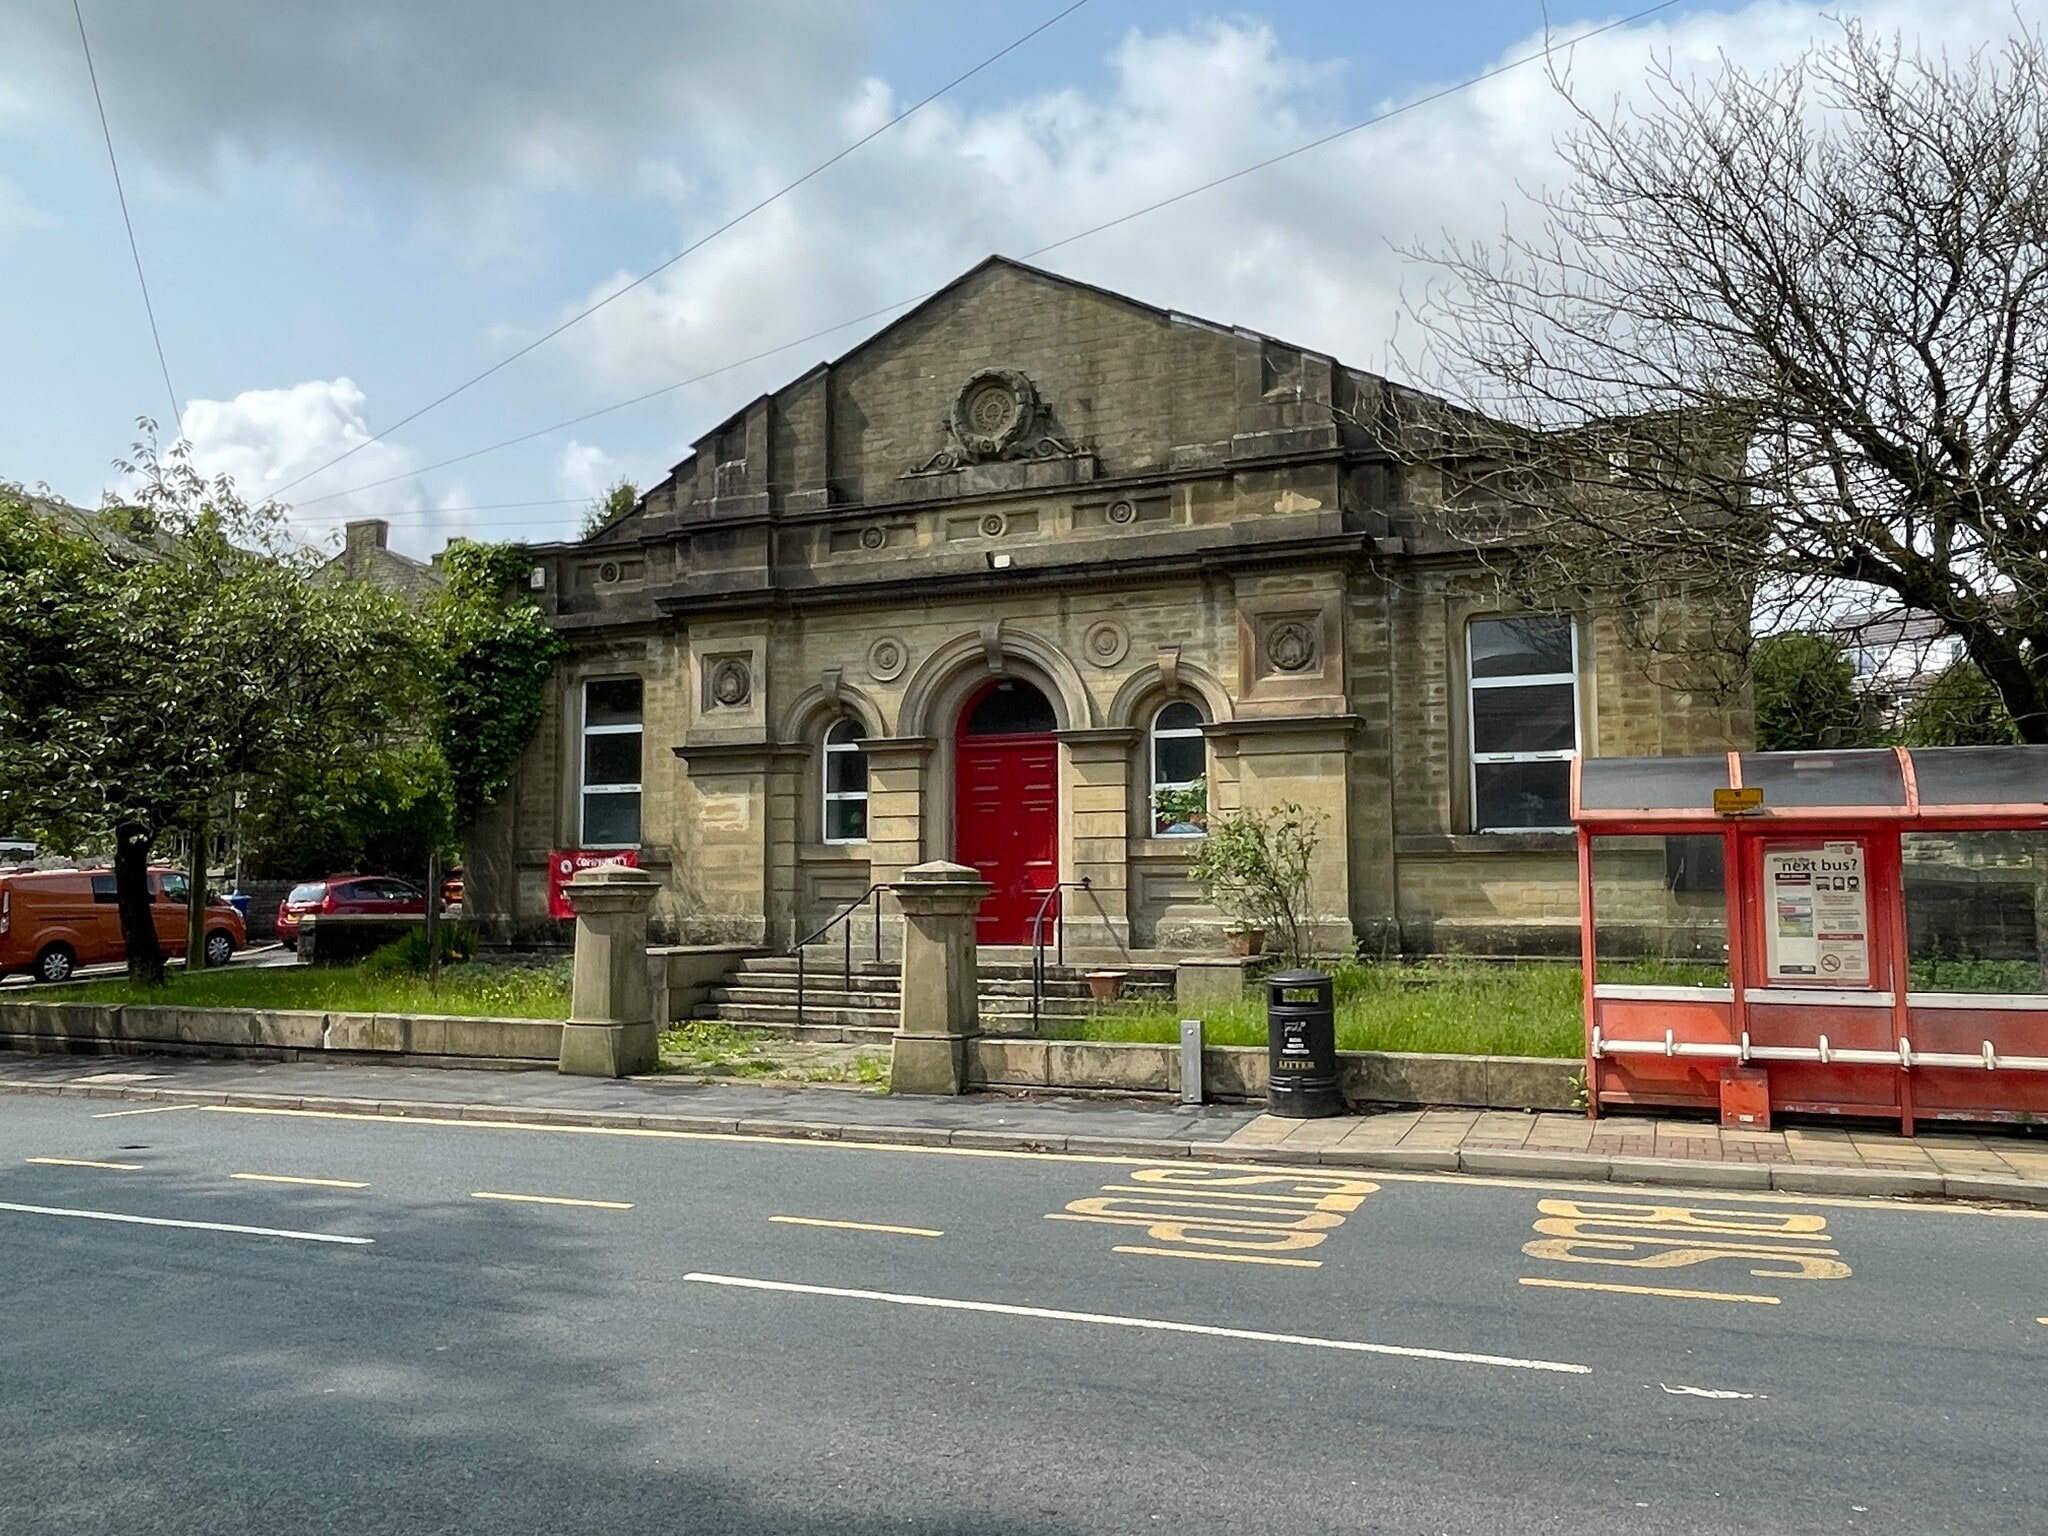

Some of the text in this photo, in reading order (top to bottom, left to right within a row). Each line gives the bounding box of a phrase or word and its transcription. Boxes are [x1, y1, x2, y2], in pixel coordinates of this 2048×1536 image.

[1782, 858, 1857, 872] next bus?
[1279, 1060, 1316, 1070] LITTER
[1043, 1168, 1382, 1251] STOP
[1521, 1198, 1853, 1279] BUS
